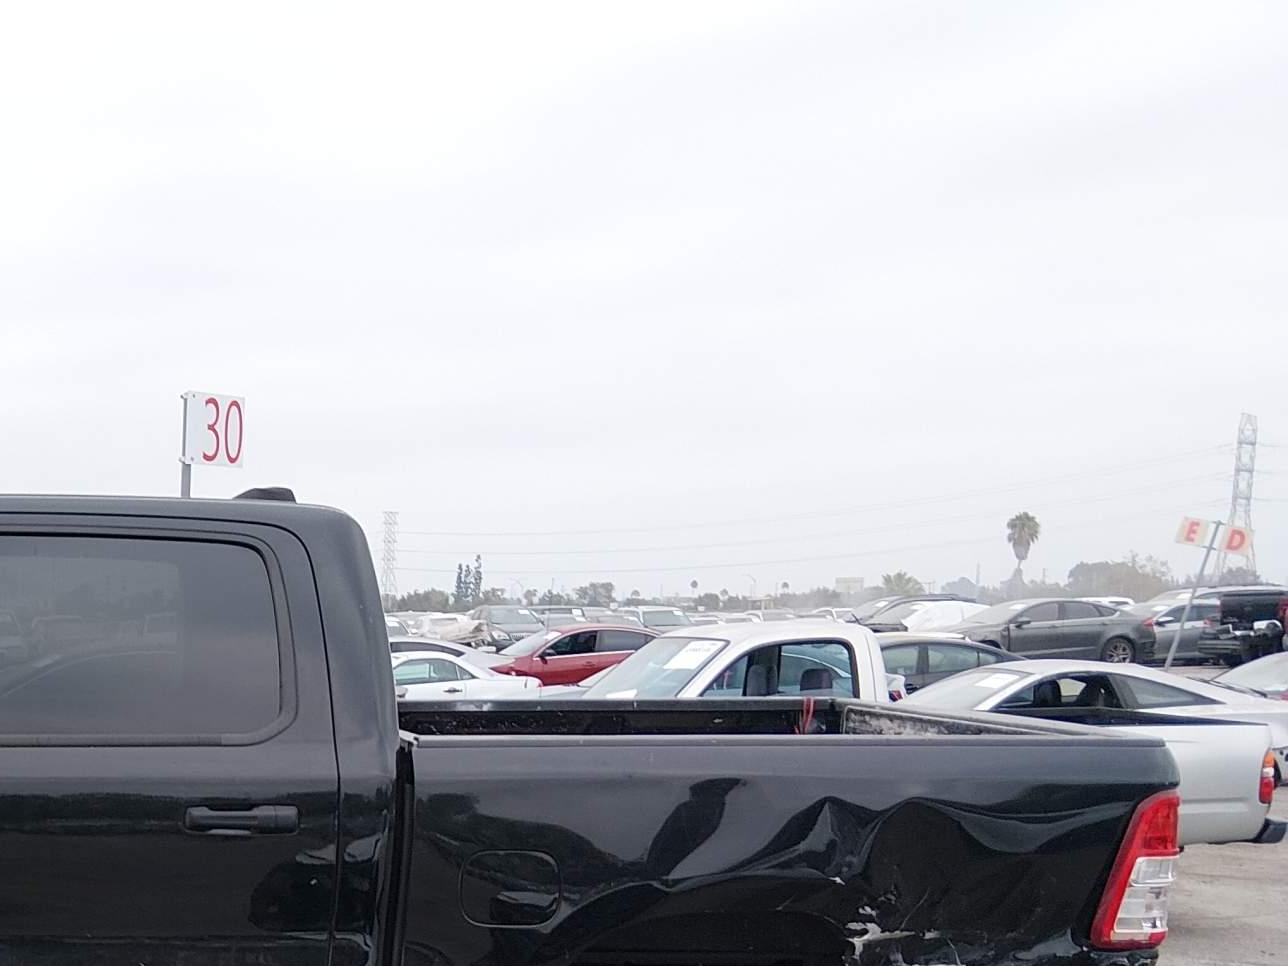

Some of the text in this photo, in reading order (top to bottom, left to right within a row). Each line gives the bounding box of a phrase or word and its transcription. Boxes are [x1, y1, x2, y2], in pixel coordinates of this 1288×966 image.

[202, 397, 243, 464] 30
[1184, 520, 1201, 543] E
[1225, 528, 1246, 551] D
